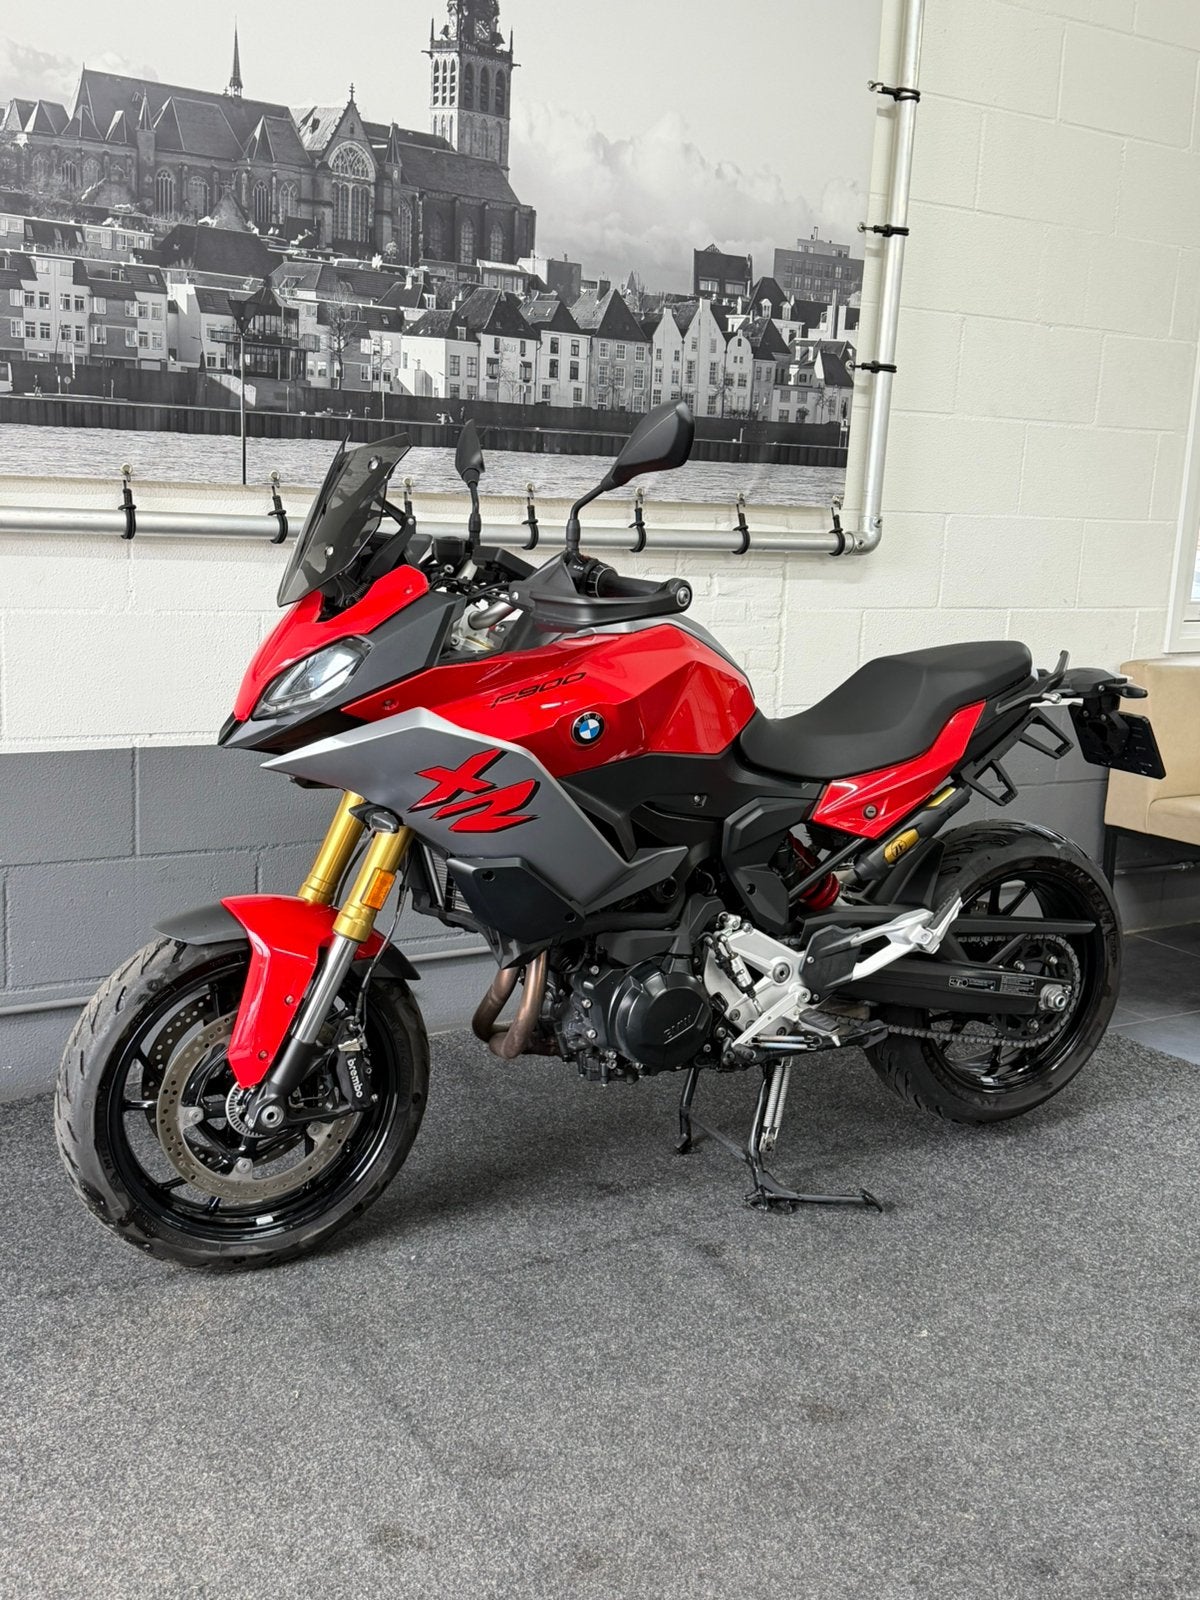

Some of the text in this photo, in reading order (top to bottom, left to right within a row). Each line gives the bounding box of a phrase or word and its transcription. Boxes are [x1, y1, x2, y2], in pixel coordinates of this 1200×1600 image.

[489, 672, 587, 709] F900
[407, 747, 541, 834] XR
[347, 1057, 363, 1098] brembo
